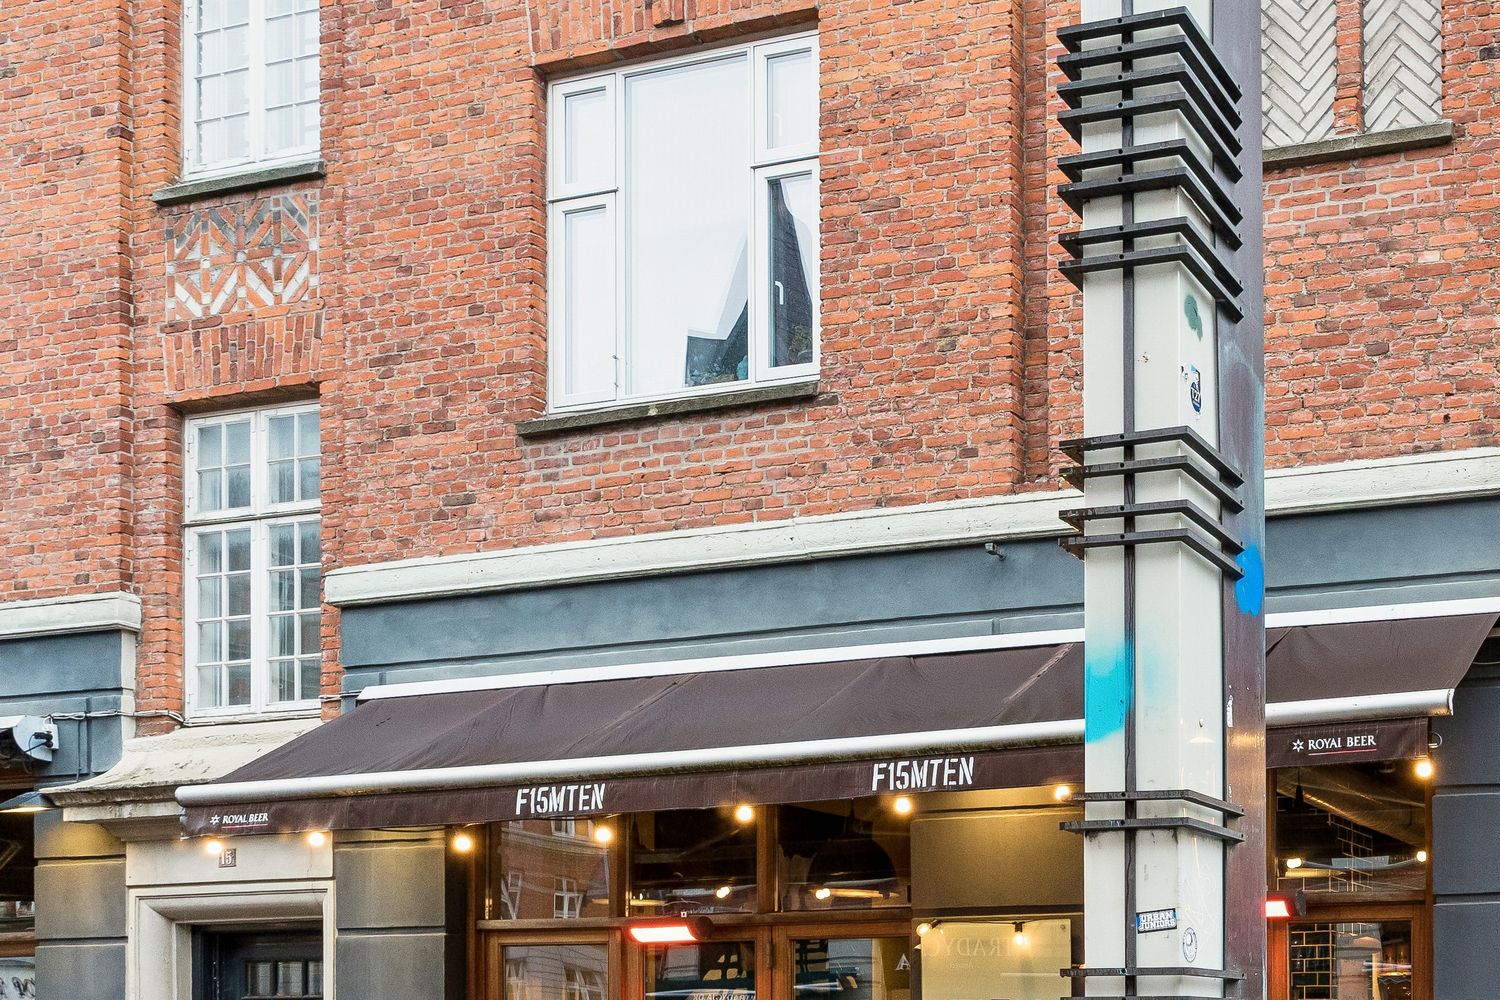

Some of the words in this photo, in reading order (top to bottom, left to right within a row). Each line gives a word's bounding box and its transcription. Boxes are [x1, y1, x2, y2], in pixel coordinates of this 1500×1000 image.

[1308, 737, 1342, 750] ROYAL
[1346, 735, 1377, 747] BEER
[872, 756, 975, 791] F15MTEN
[515, 783, 606, 815] F15MTEN
[222, 814, 248, 824] ROYAL
[249, 813, 269, 823] BEER
[221, 851, 233, 866] 15
[1139, 910, 1173, 922] URBAN
[1140, 918, 1176, 929] JUNIORS
